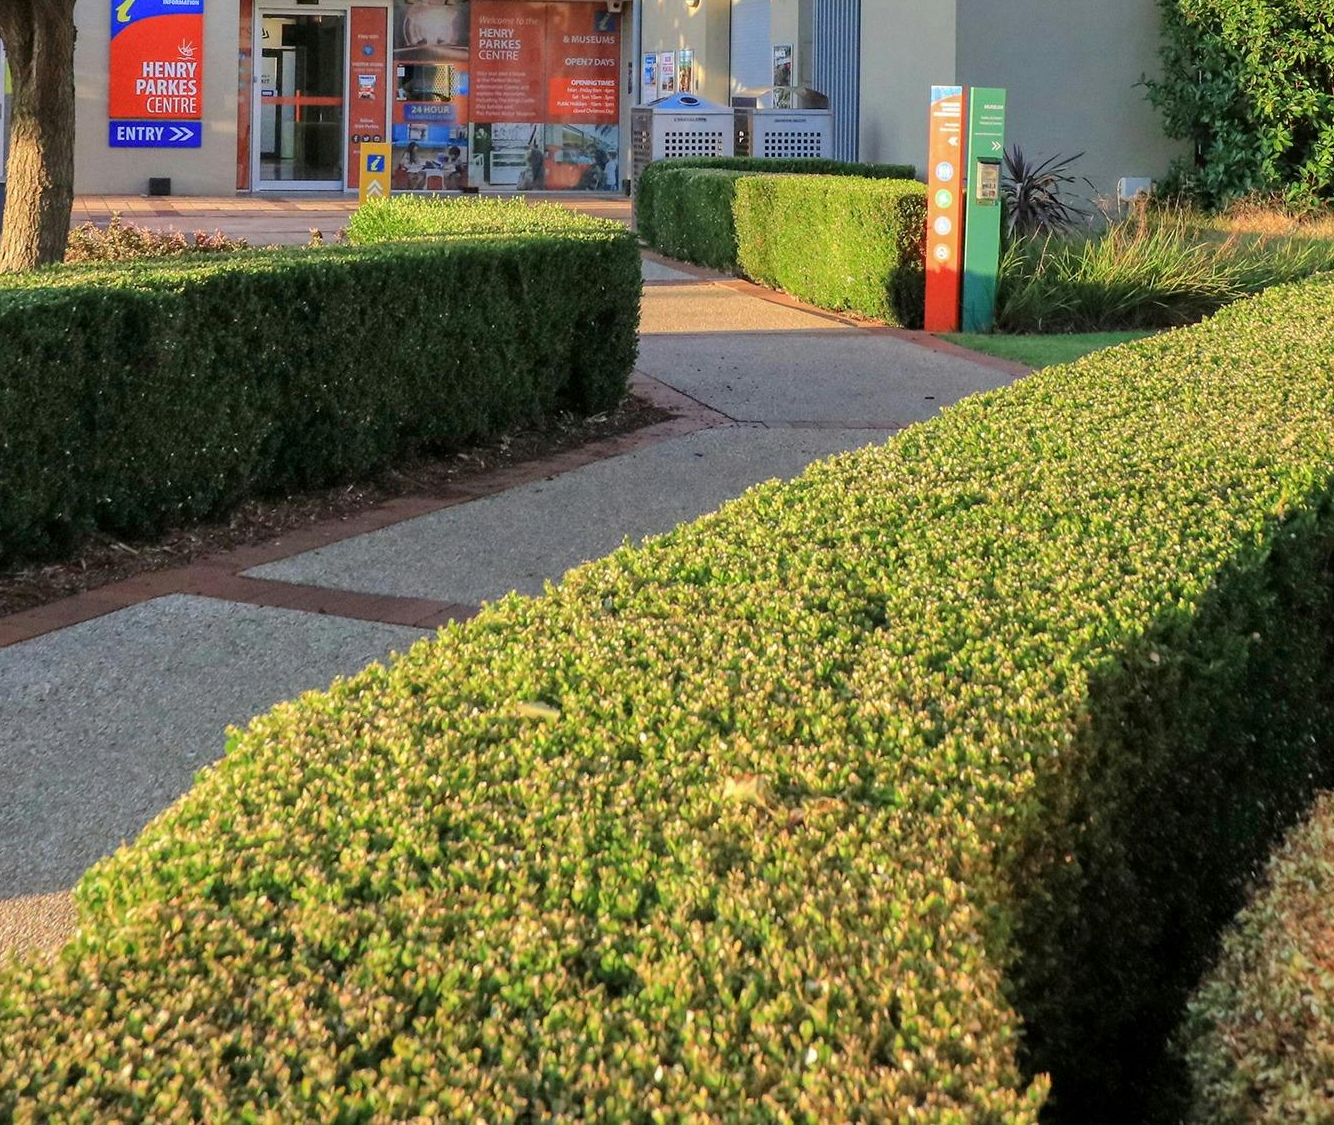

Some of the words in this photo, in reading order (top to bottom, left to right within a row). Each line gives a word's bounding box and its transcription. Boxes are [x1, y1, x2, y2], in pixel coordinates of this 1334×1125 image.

[479, 16, 514, 25] Welcome
[516, 17, 524, 25] to
[525, 17, 539, 25] the
[478, 28, 514, 38] HENRY
[478, 39, 521, 50] PARKES
[563, 36, 571, 44] &
[571, 35, 615, 44] MUSEUMS
[478, 50, 519, 61] CENTRE
[565, 58, 587, 66] OPEN
[594, 58, 615, 66] DAYS
[142, 62, 197, 77] HENRY
[136, 79, 197, 95] PARKES
[147, 97, 197, 113] CENTRE
[411, 106, 422, 114] 24
[424, 106, 449, 114] HOUR
[117, 127, 164, 140] ENTRY
